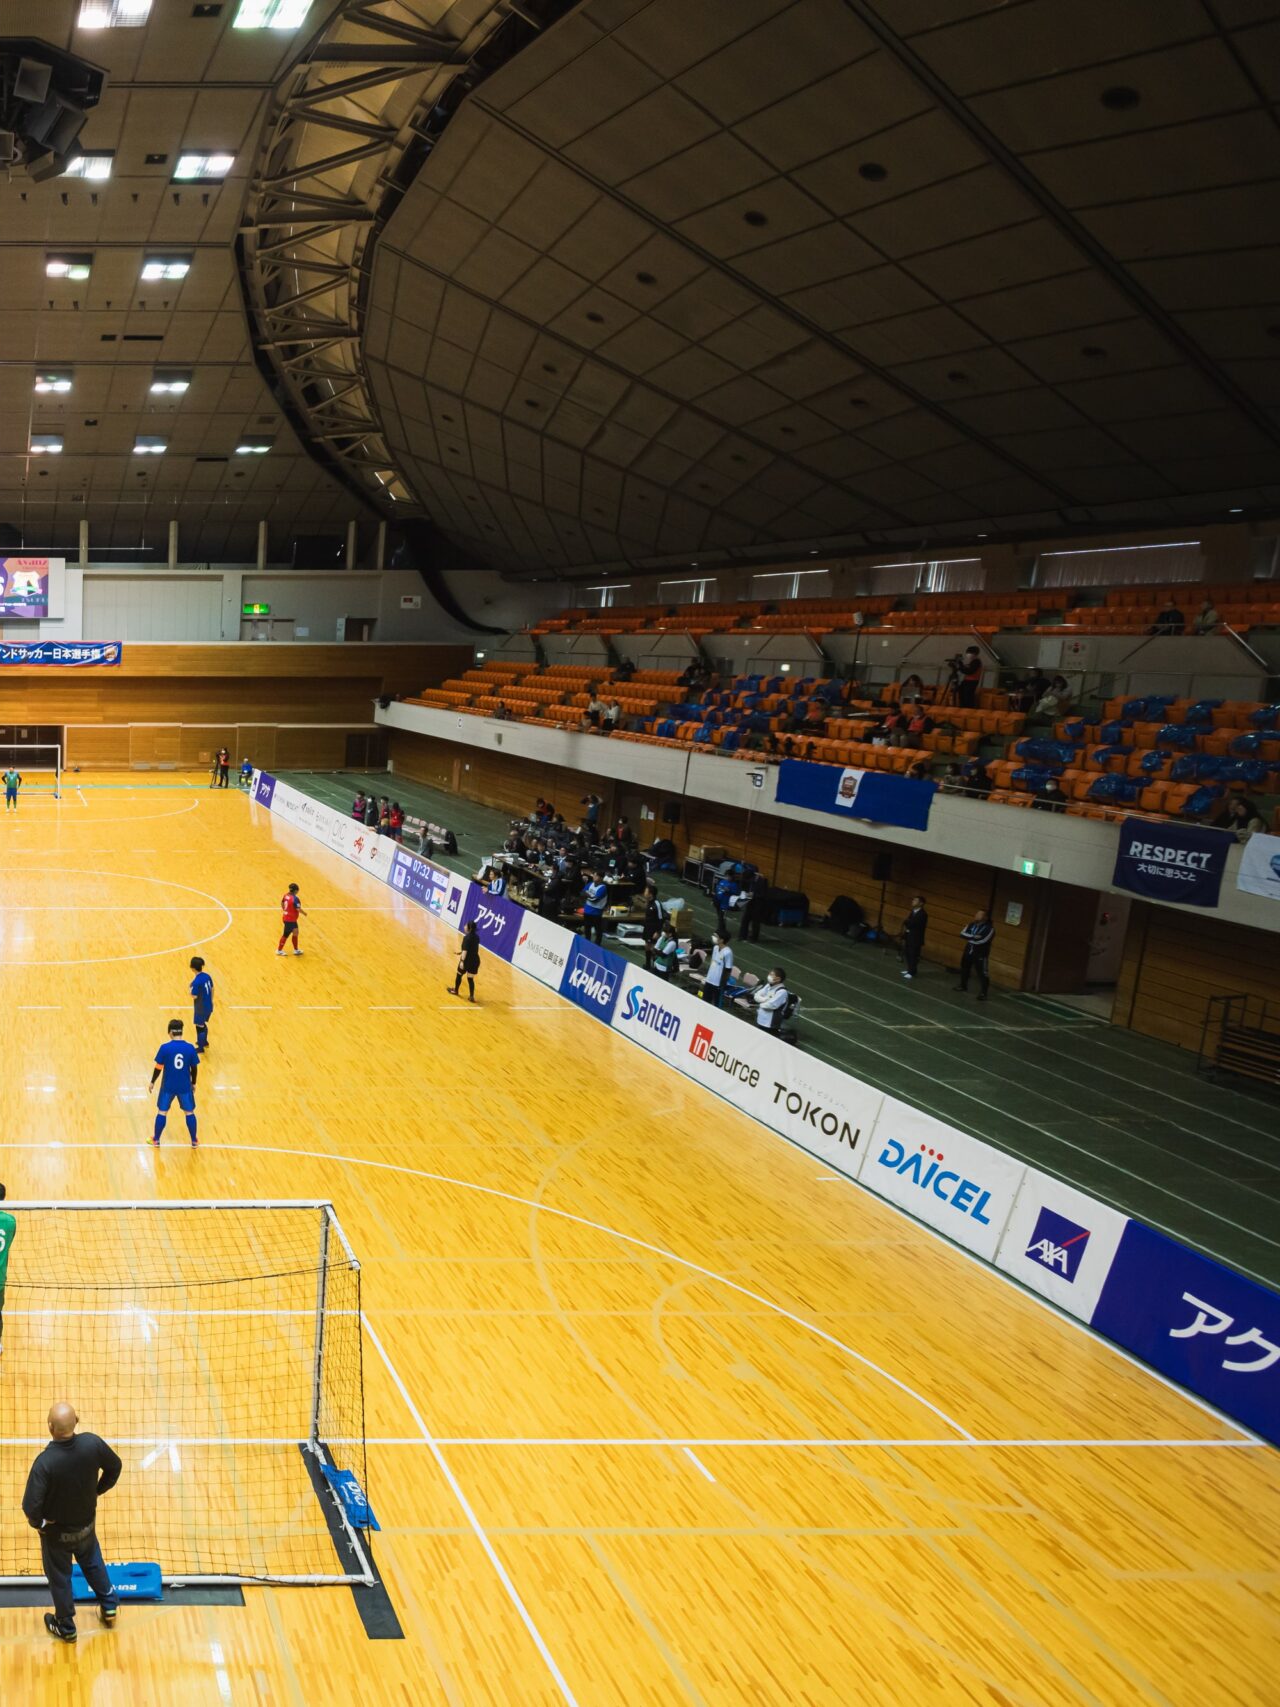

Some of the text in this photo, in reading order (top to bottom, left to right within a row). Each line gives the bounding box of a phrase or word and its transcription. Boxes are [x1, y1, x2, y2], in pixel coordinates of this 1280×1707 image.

[413, 859, 431, 879] 07:32
[1129, 841, 1213, 868] RESPECT
[405, 875, 411, 888] 3
[1137, 863, 1197, 882] 大切に思うこと
[425, 888, 431, 901] 0
[474, 904, 506, 936] アクサ
[569, 967, 613, 1006] KPMG
[621, 985, 681, 1042] Santen
[174, 1053, 184, 1070] 6
[692, 1031, 760, 1088] insource
[773, 1081, 861, 1150] TOKON
[1025, 1238, 1068, 1275] AXA
